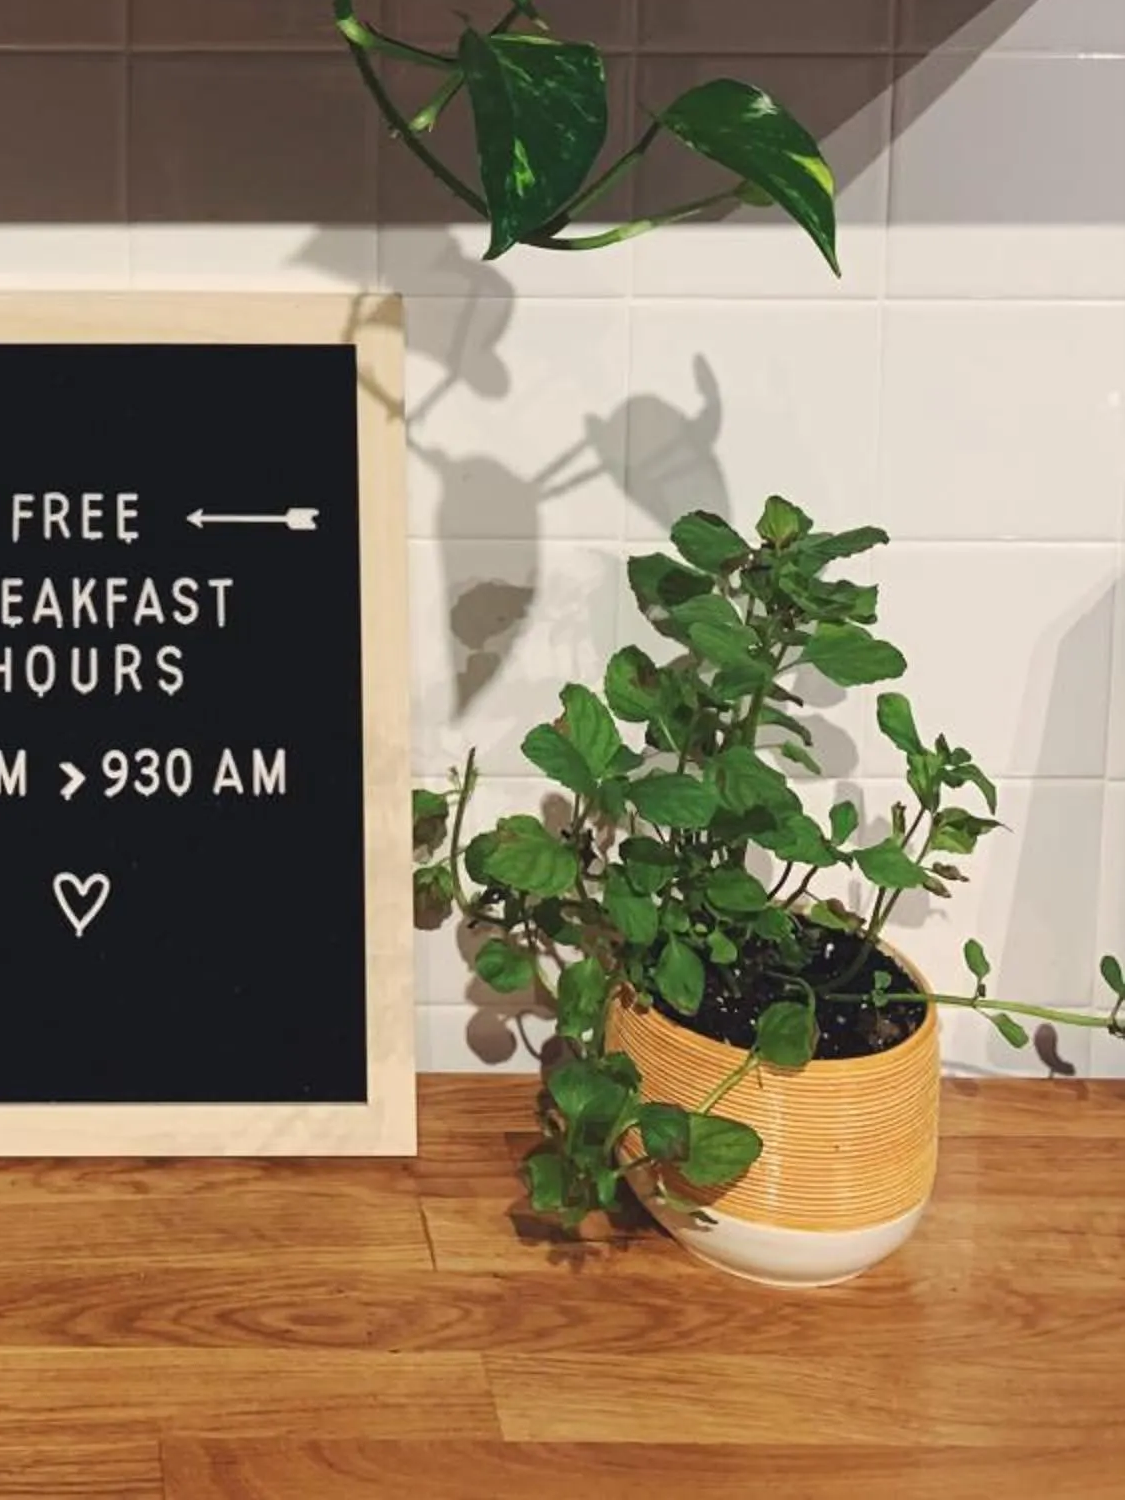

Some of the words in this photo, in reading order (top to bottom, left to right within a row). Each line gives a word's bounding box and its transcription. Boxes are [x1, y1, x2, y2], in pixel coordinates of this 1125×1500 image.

[11, 490, 140, 544] FREE
[101, 746, 193, 799] 930
[212, 747, 287, 797] AM
